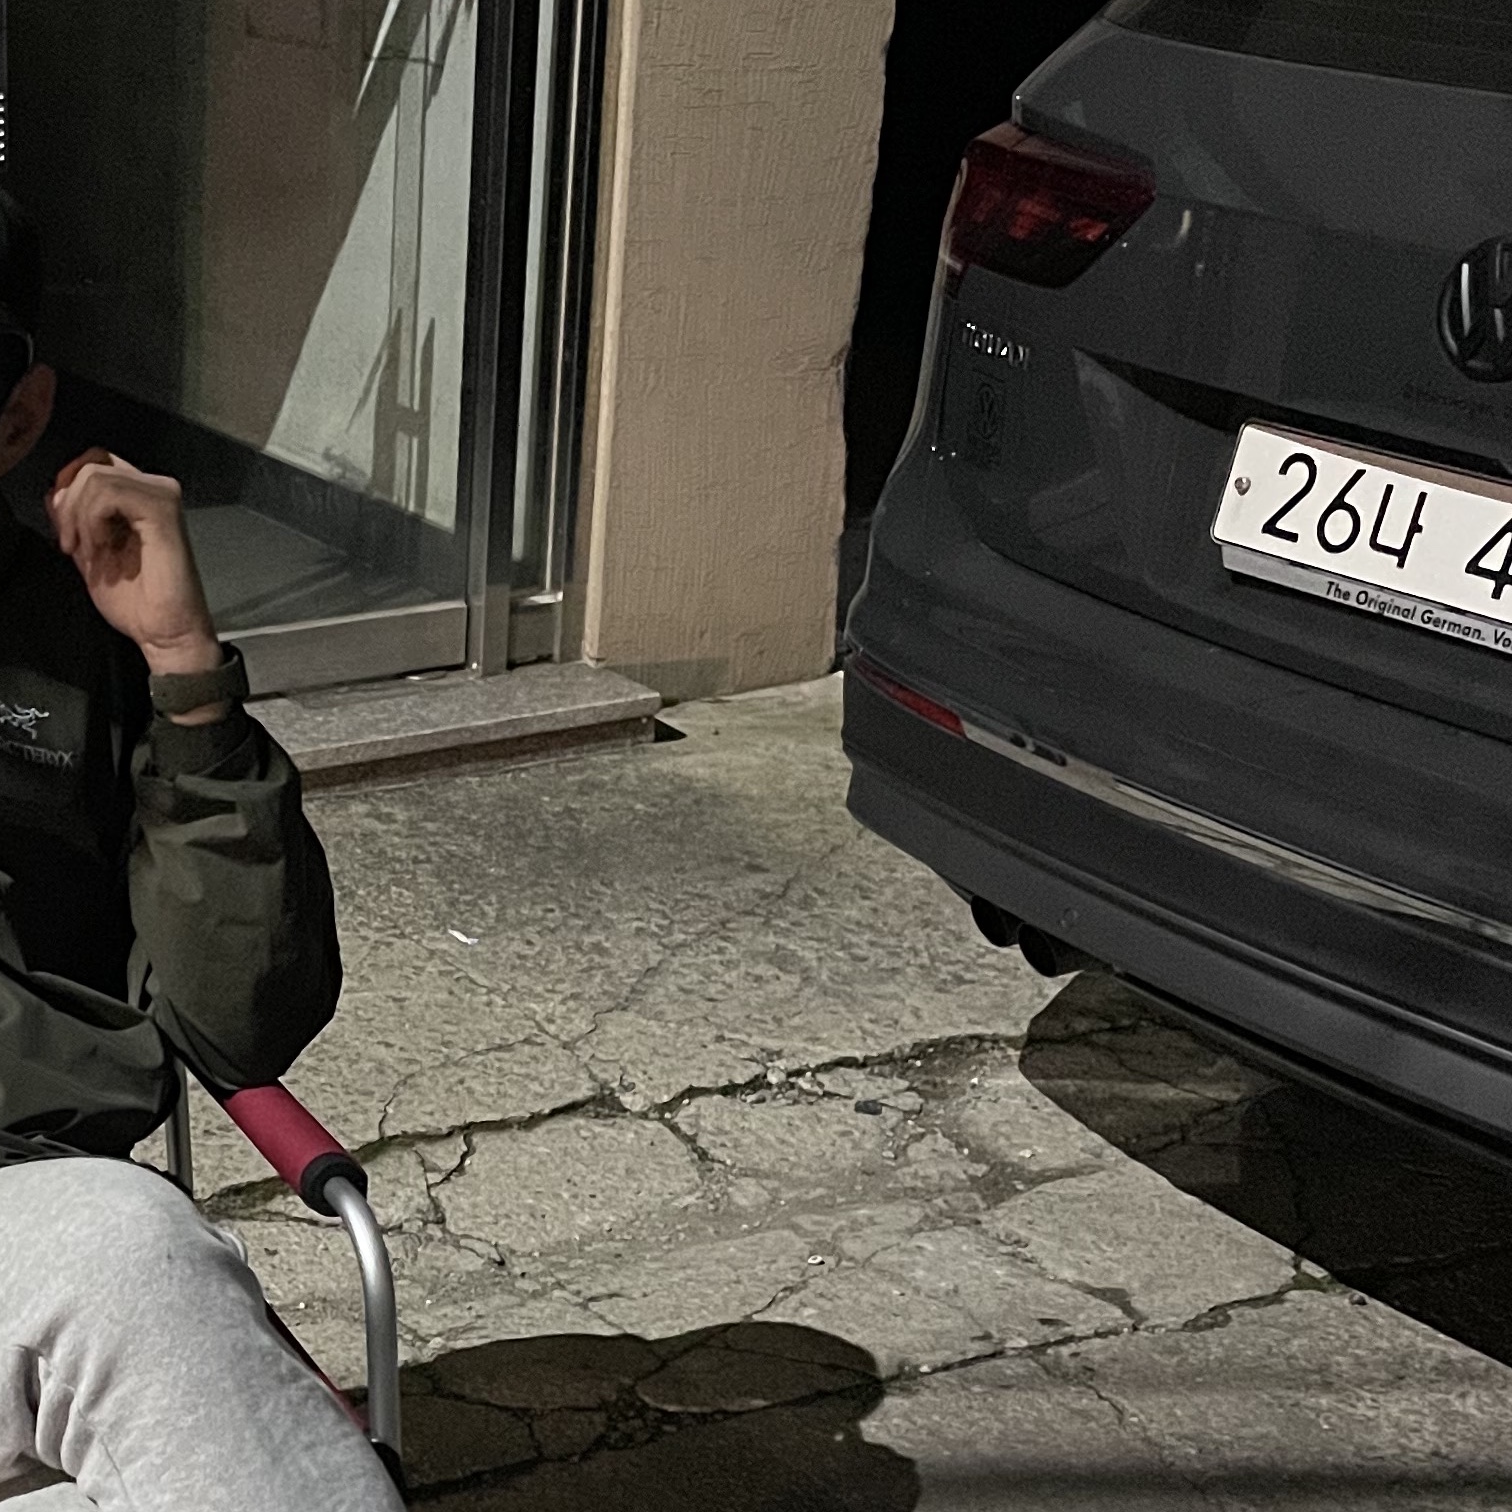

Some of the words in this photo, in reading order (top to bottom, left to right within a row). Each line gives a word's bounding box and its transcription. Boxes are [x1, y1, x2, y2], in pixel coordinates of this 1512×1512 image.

[1261, 452, 1428, 568] 26나
[1325, 581, 1351, 601] The
[1355, 590, 1417, 621] Original
[1420, 609, 1486, 641] German.
